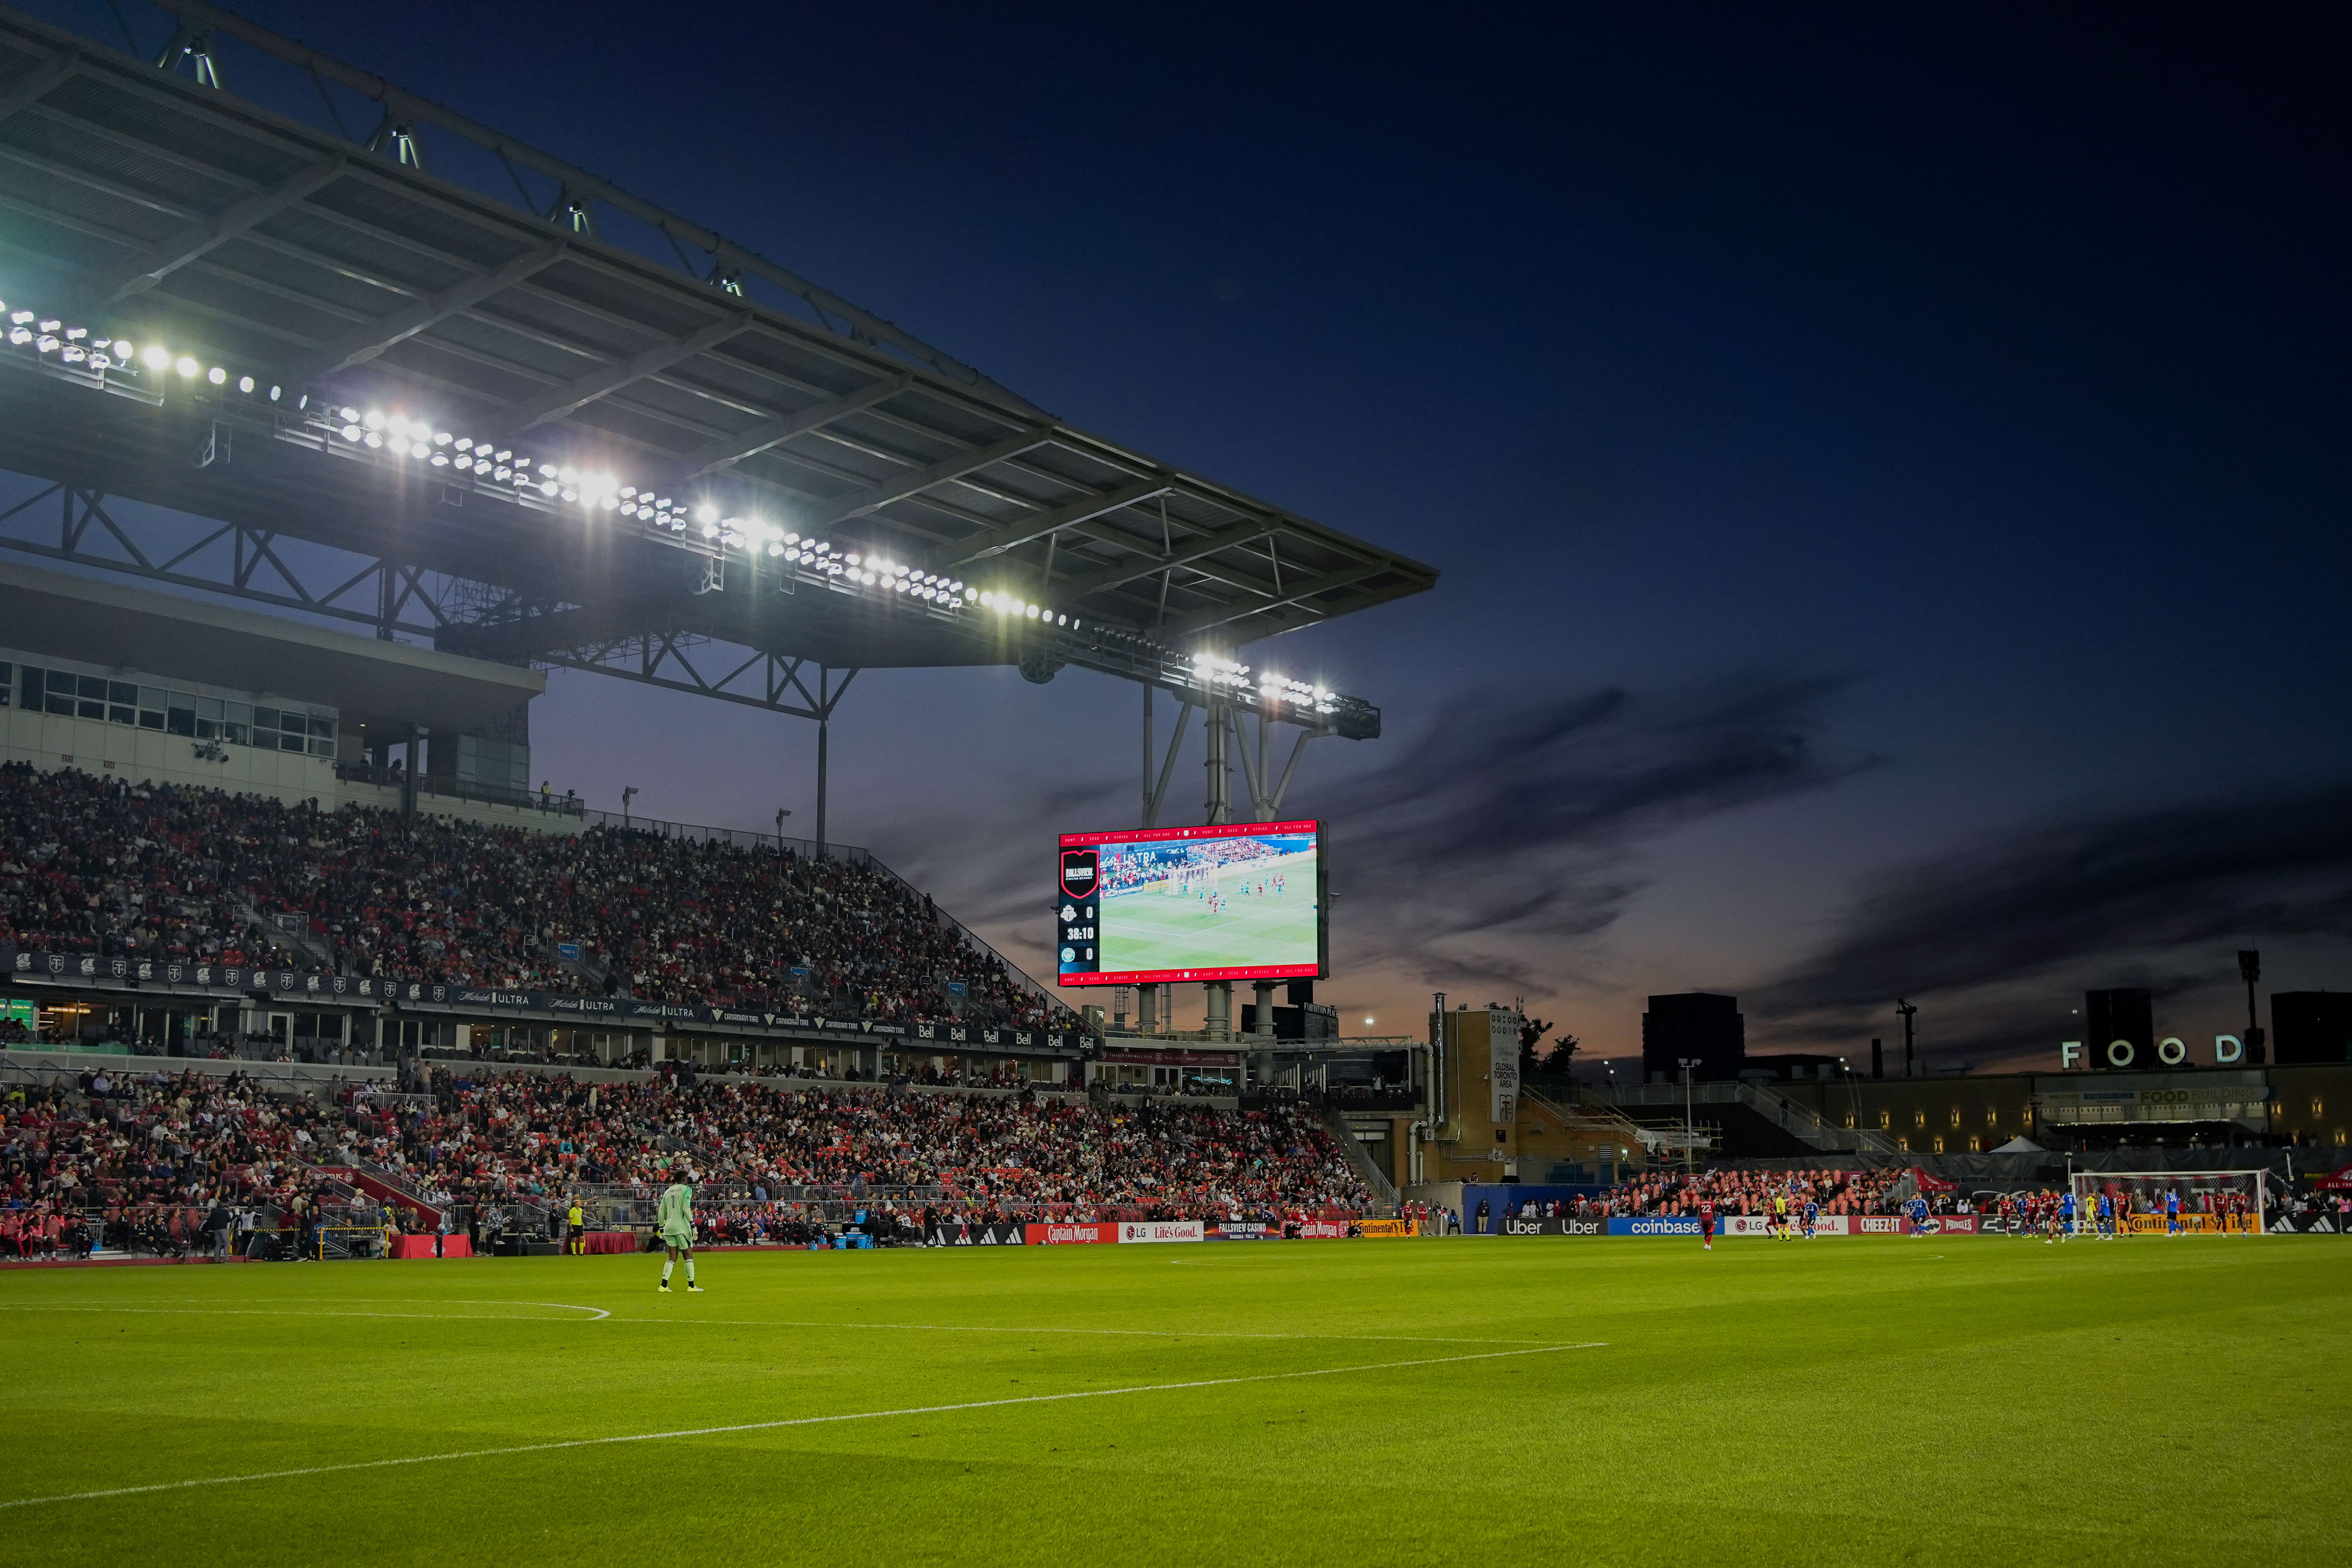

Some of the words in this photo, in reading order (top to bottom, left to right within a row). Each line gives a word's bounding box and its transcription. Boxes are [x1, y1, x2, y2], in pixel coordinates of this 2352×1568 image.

[1087, 907, 1093, 918] 0
[1067, 927, 1094, 940] 38:10
[1086, 948, 1093, 960] 0
[458, 991, 490, 1002] Michelob
[498, 994, 529, 1005] ULTRA
[549, 998, 578, 1009] Michelob
[586, 1001, 614, 1011] ULTRA
[633, 1004, 661, 1014] Michelob
[668, 1007, 694, 1018] ULTRA
[1304, 1002, 1327, 1015] EXHIBITION
[724, 1013, 749, 1022] CANADIAN
[826, 1021, 848, 1029] CANADIAN
[873, 1025, 895, 1033] CANADIAN
[919, 1025, 934, 1038] Bell
[951, 1027, 966, 1041] Bell
[984, 1030, 999, 1043] Bell
[1016, 1032, 1031, 1045] Bell
[1048, 1034, 1063, 1047] Bell
[1080, 1036, 1094, 1049] Bell
[2062, 1034, 2243, 1069] FOOD
[1495, 1062, 1515, 1071] GLOBAL
[1494, 1071, 1517, 1080] TORONTO
[1499, 1080, 1512, 1088] AREA
[2140, 1091, 2189, 1103] FOOD
[2192, 1088, 2254, 1099] BUILDING
[671, 1195, 675, 1209] 1
[1701, 1204, 1711, 1213] 22
[1218, 1223, 1246, 1233] FALLSVIEW
[1247, 1223, 1267, 1232] CASINO
[1316, 1221, 1337, 1239] Morgan
[1506, 1220, 1542, 1235] Uber
[1562, 1219, 1599, 1234] Uber
[1632, 1219, 1701, 1234] coinbase
[1749, 1221, 1762, 1230] LG
[1813, 1220, 1838, 1231] ood.
[1945, 1218, 1972, 1231] PRINGLES
[1048, 1225, 1073, 1244] Captain
[1072, 1225, 1098, 1243] Morgan
[1136, 1227, 1146, 1238] LG
[1155, 1226, 1173, 1239] Life's
[1174, 1226, 1197, 1238] Good.
